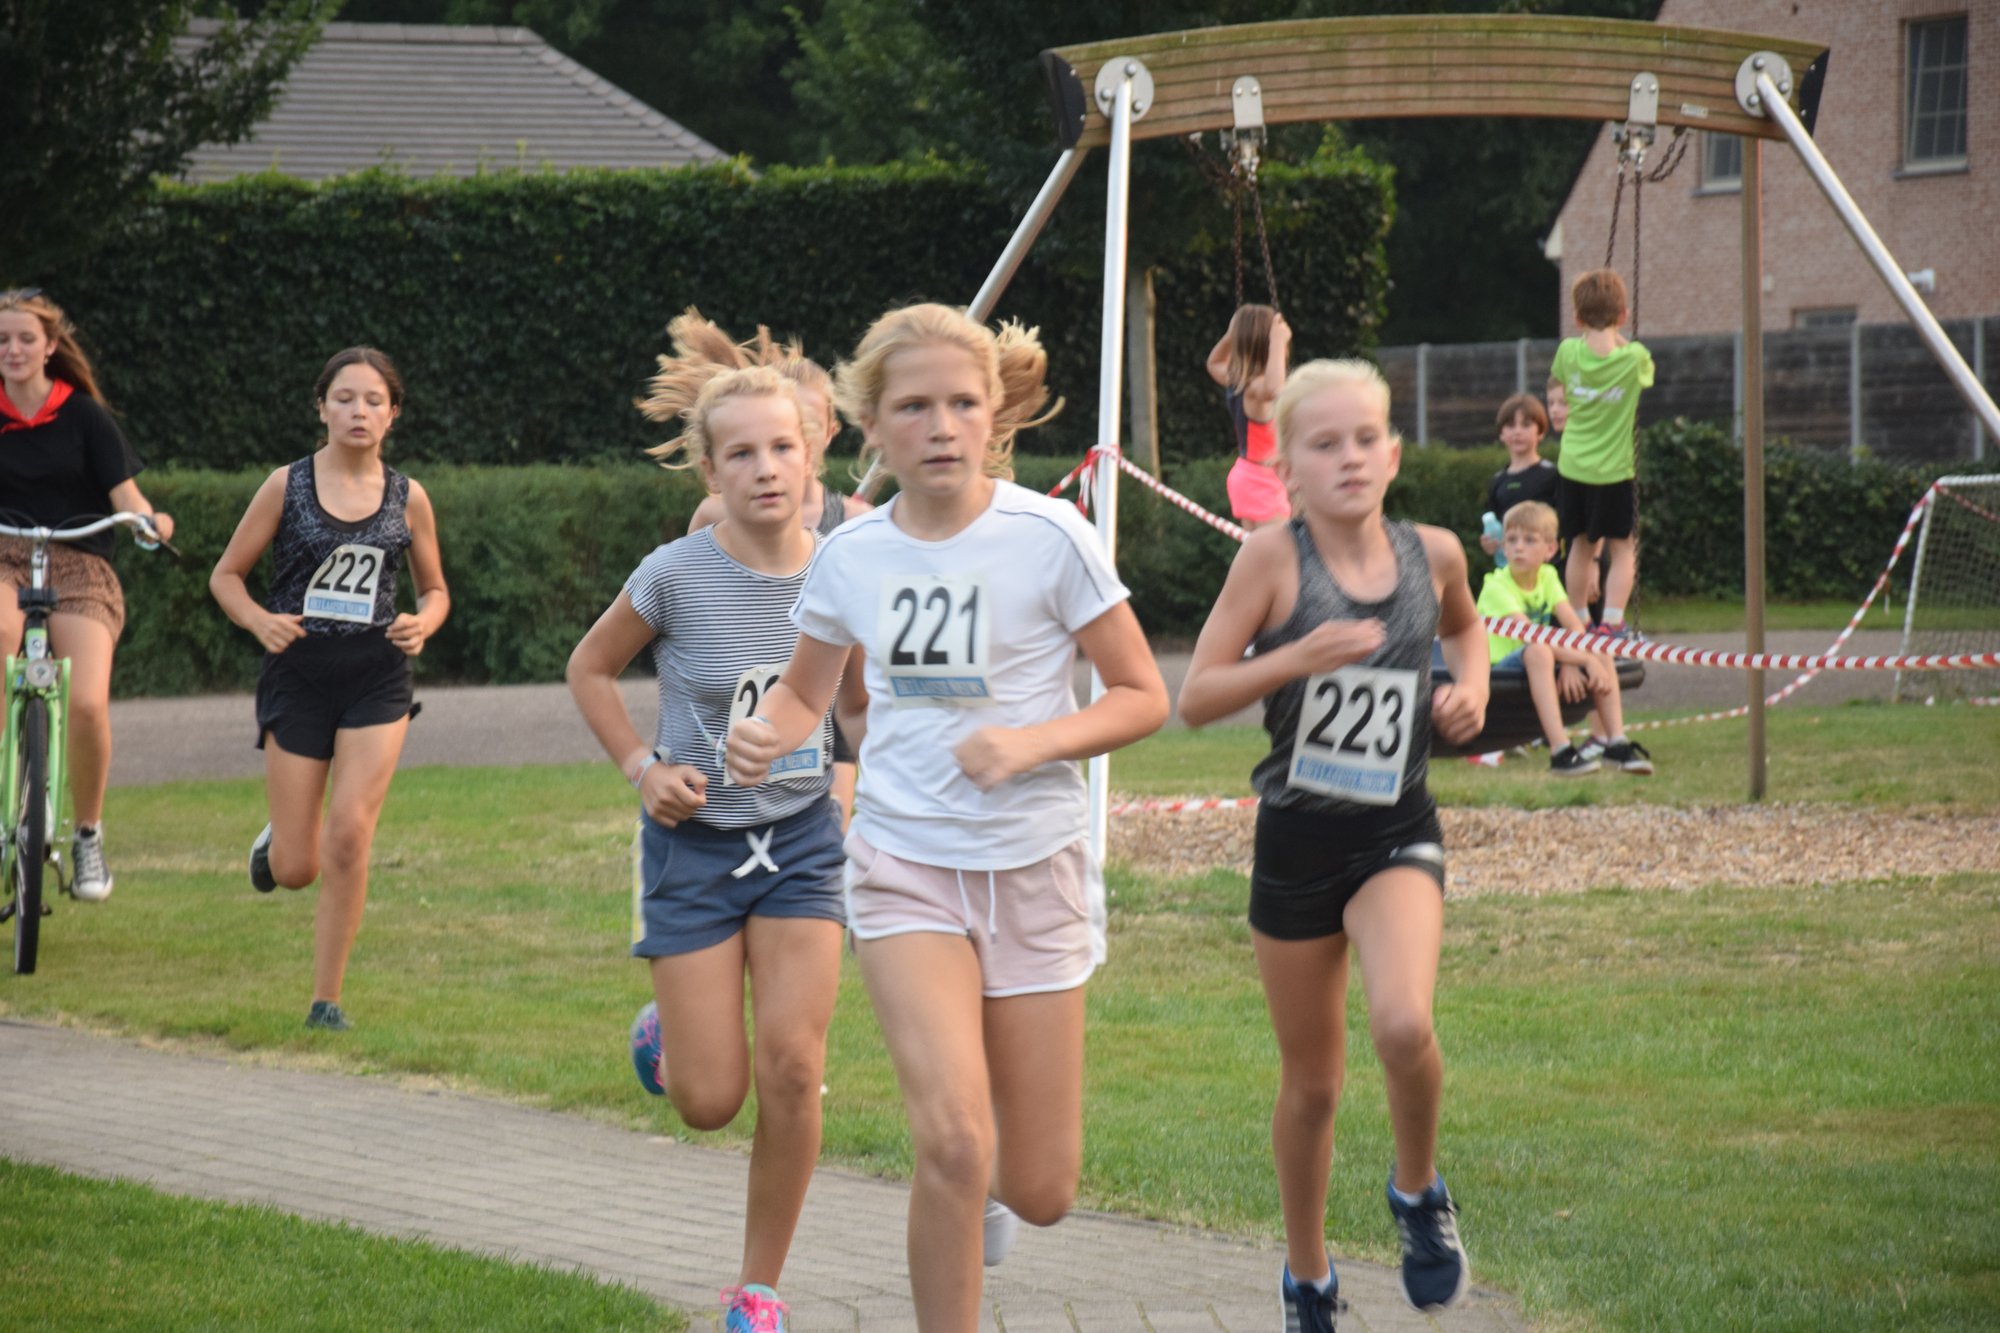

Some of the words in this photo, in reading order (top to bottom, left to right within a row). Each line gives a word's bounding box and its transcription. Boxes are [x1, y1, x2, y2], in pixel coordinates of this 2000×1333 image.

[313, 552, 376, 595] 222
[890, 585, 979, 665] 221
[1304, 680, 1403, 759] 223
